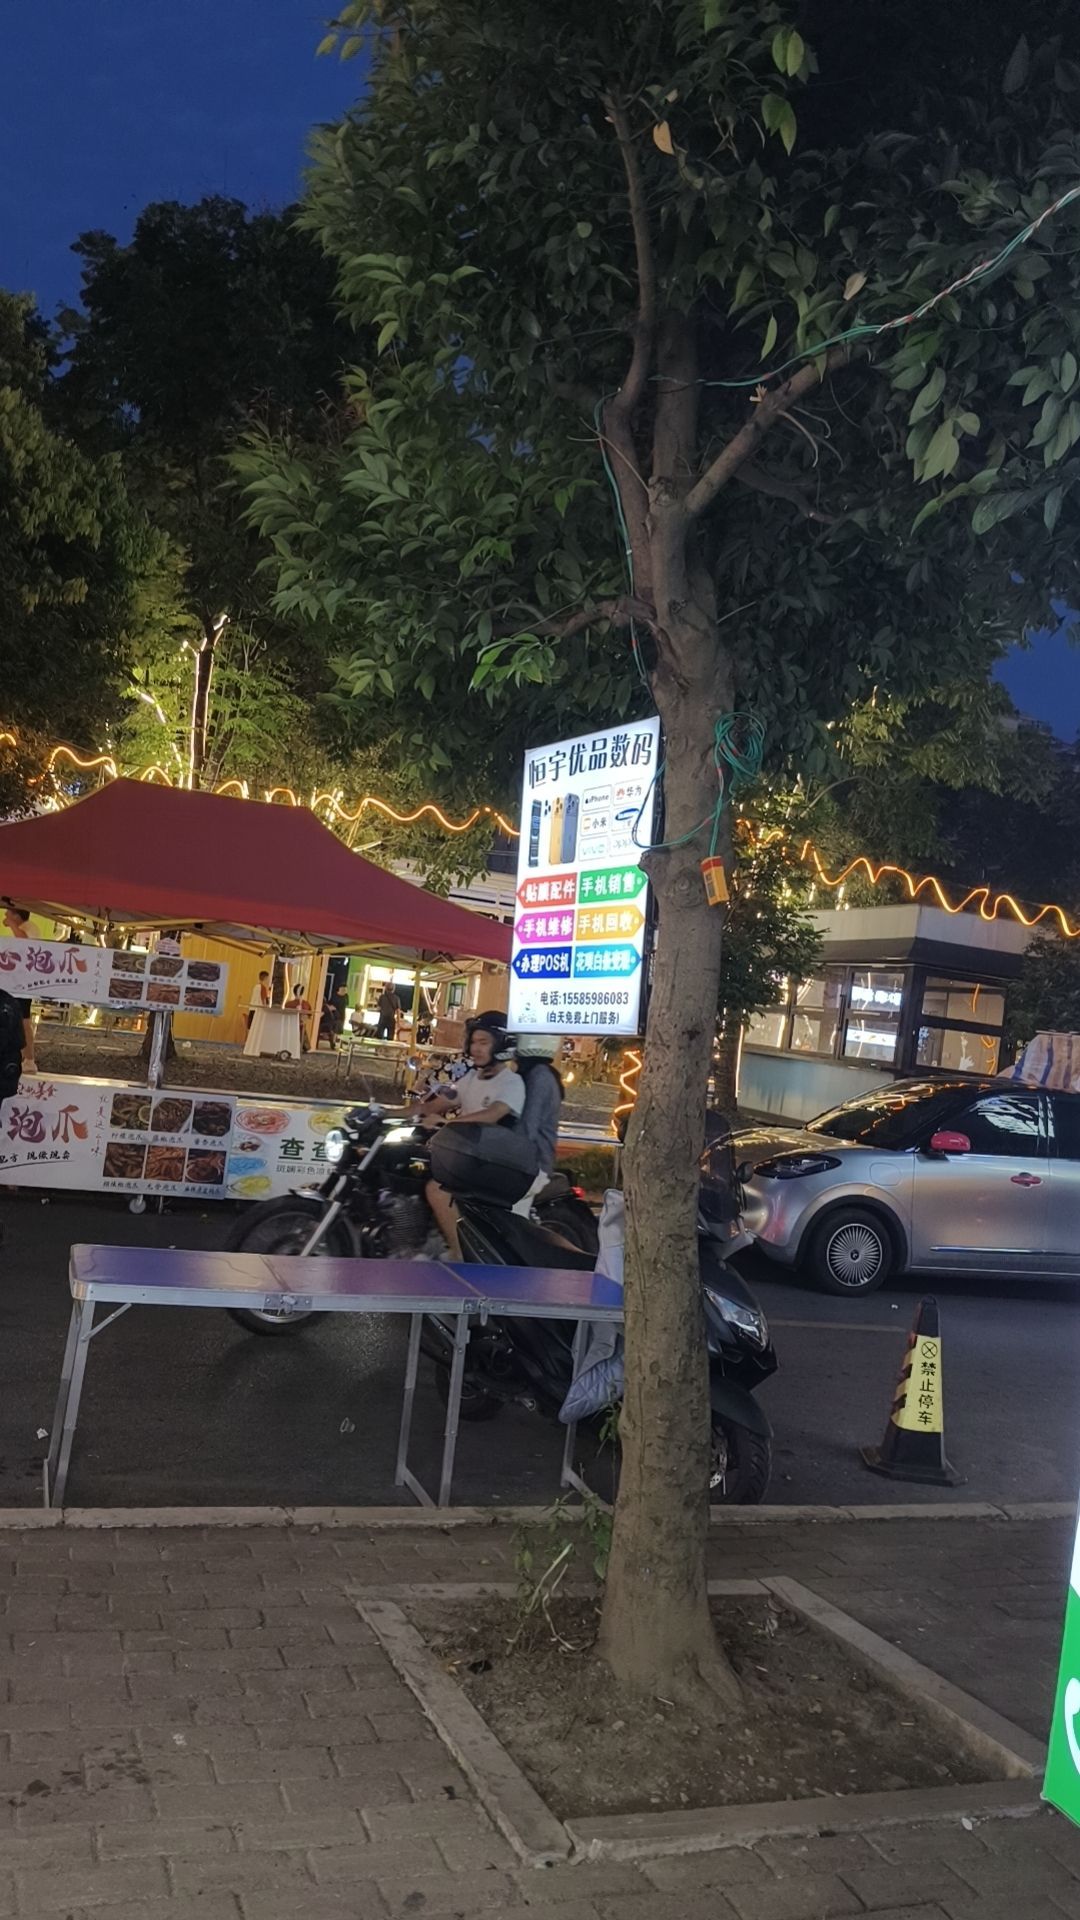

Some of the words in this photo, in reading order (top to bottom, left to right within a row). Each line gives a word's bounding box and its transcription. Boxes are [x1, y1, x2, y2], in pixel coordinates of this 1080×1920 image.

[529, 733, 653, 789] 恒宇优品数码
[589, 794, 609, 803] iPhone
[626, 785, 642, 797] 华为
[592, 817, 607, 829] 小米
[525, 879, 575, 902] 贴膜配件
[581, 871, 636, 897] 手机销售
[523, 915, 573, 938] 手机维修
[578, 911, 633, 935] 手机回收
[521, 952, 569, 973] 办理POS机
[7, 1104, 88, 1144] 泡爪
[918, 1361, 936, 1425] 禁止停车
